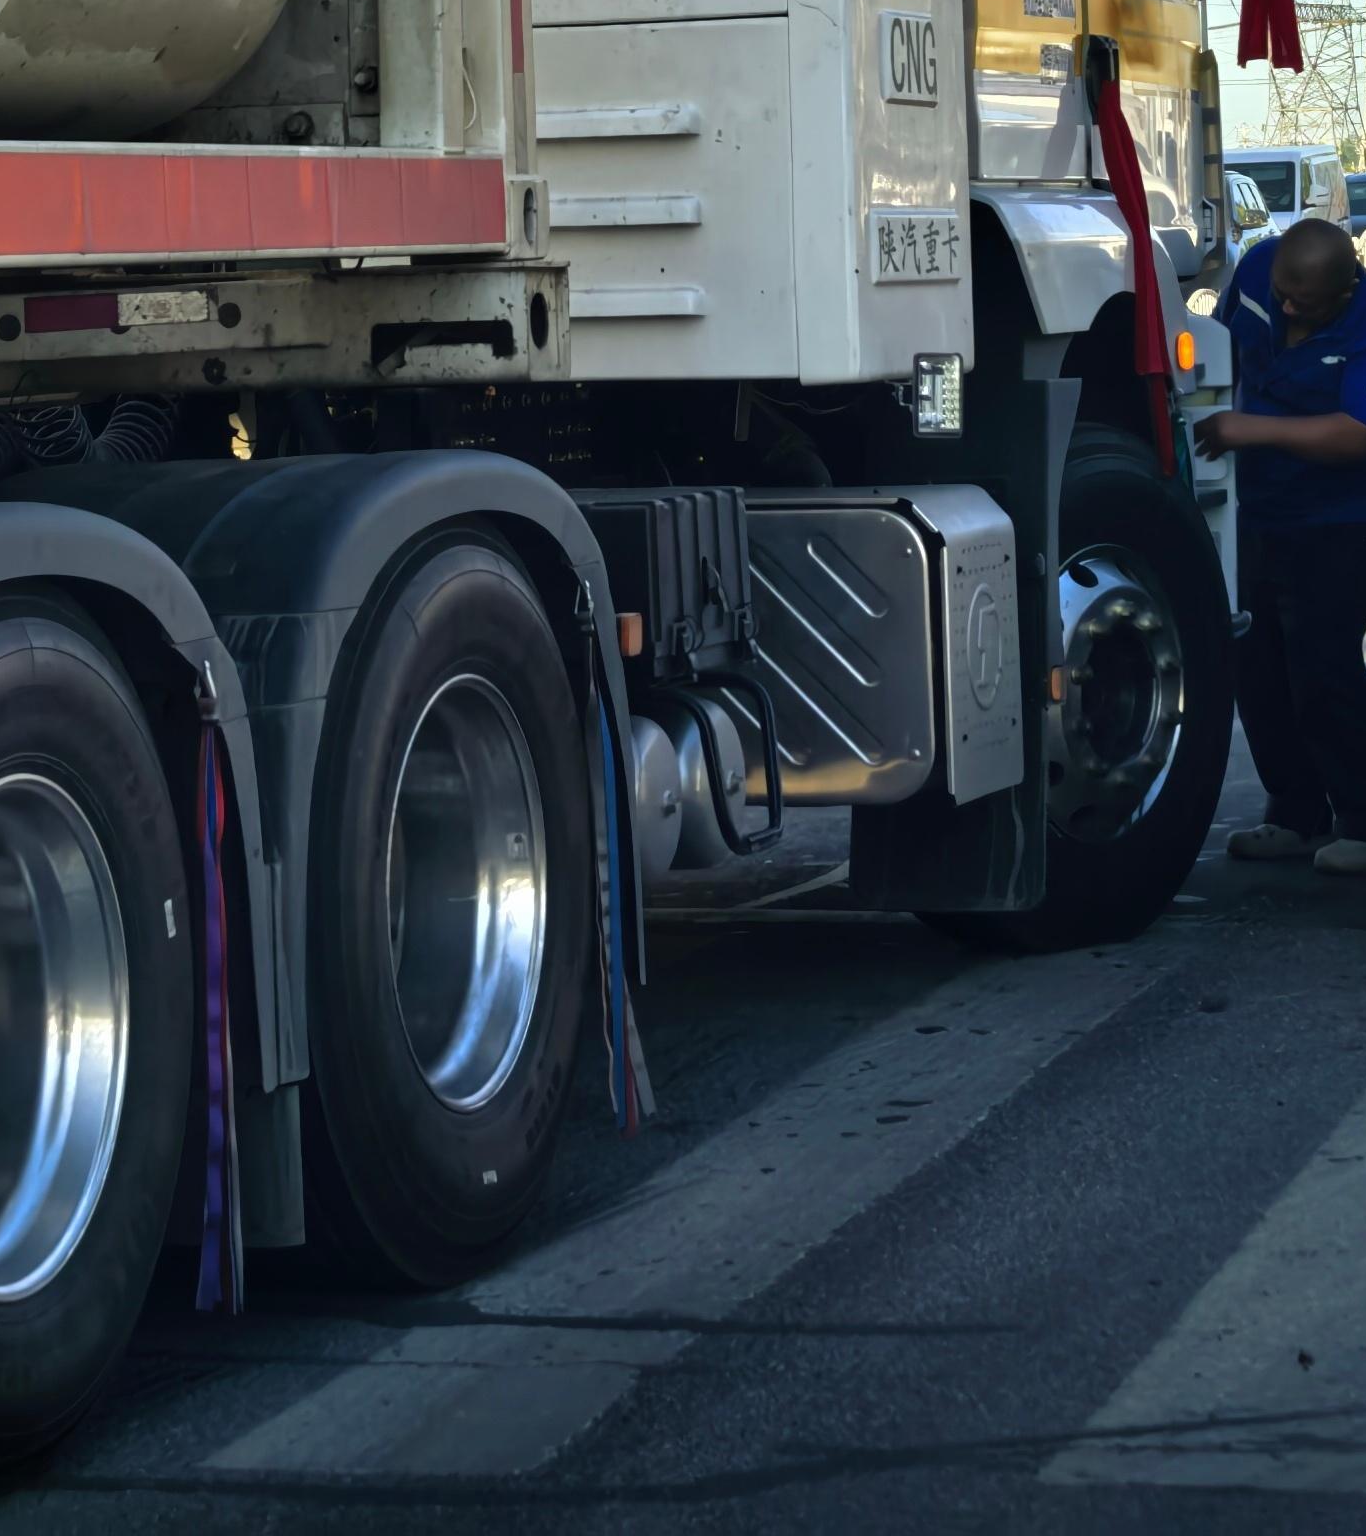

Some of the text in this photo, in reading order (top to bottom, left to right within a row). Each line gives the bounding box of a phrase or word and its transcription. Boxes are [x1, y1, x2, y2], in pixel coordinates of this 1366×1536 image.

[890, 17, 938, 96] CNG
[878, 218, 960, 276] 陕汽重卡
